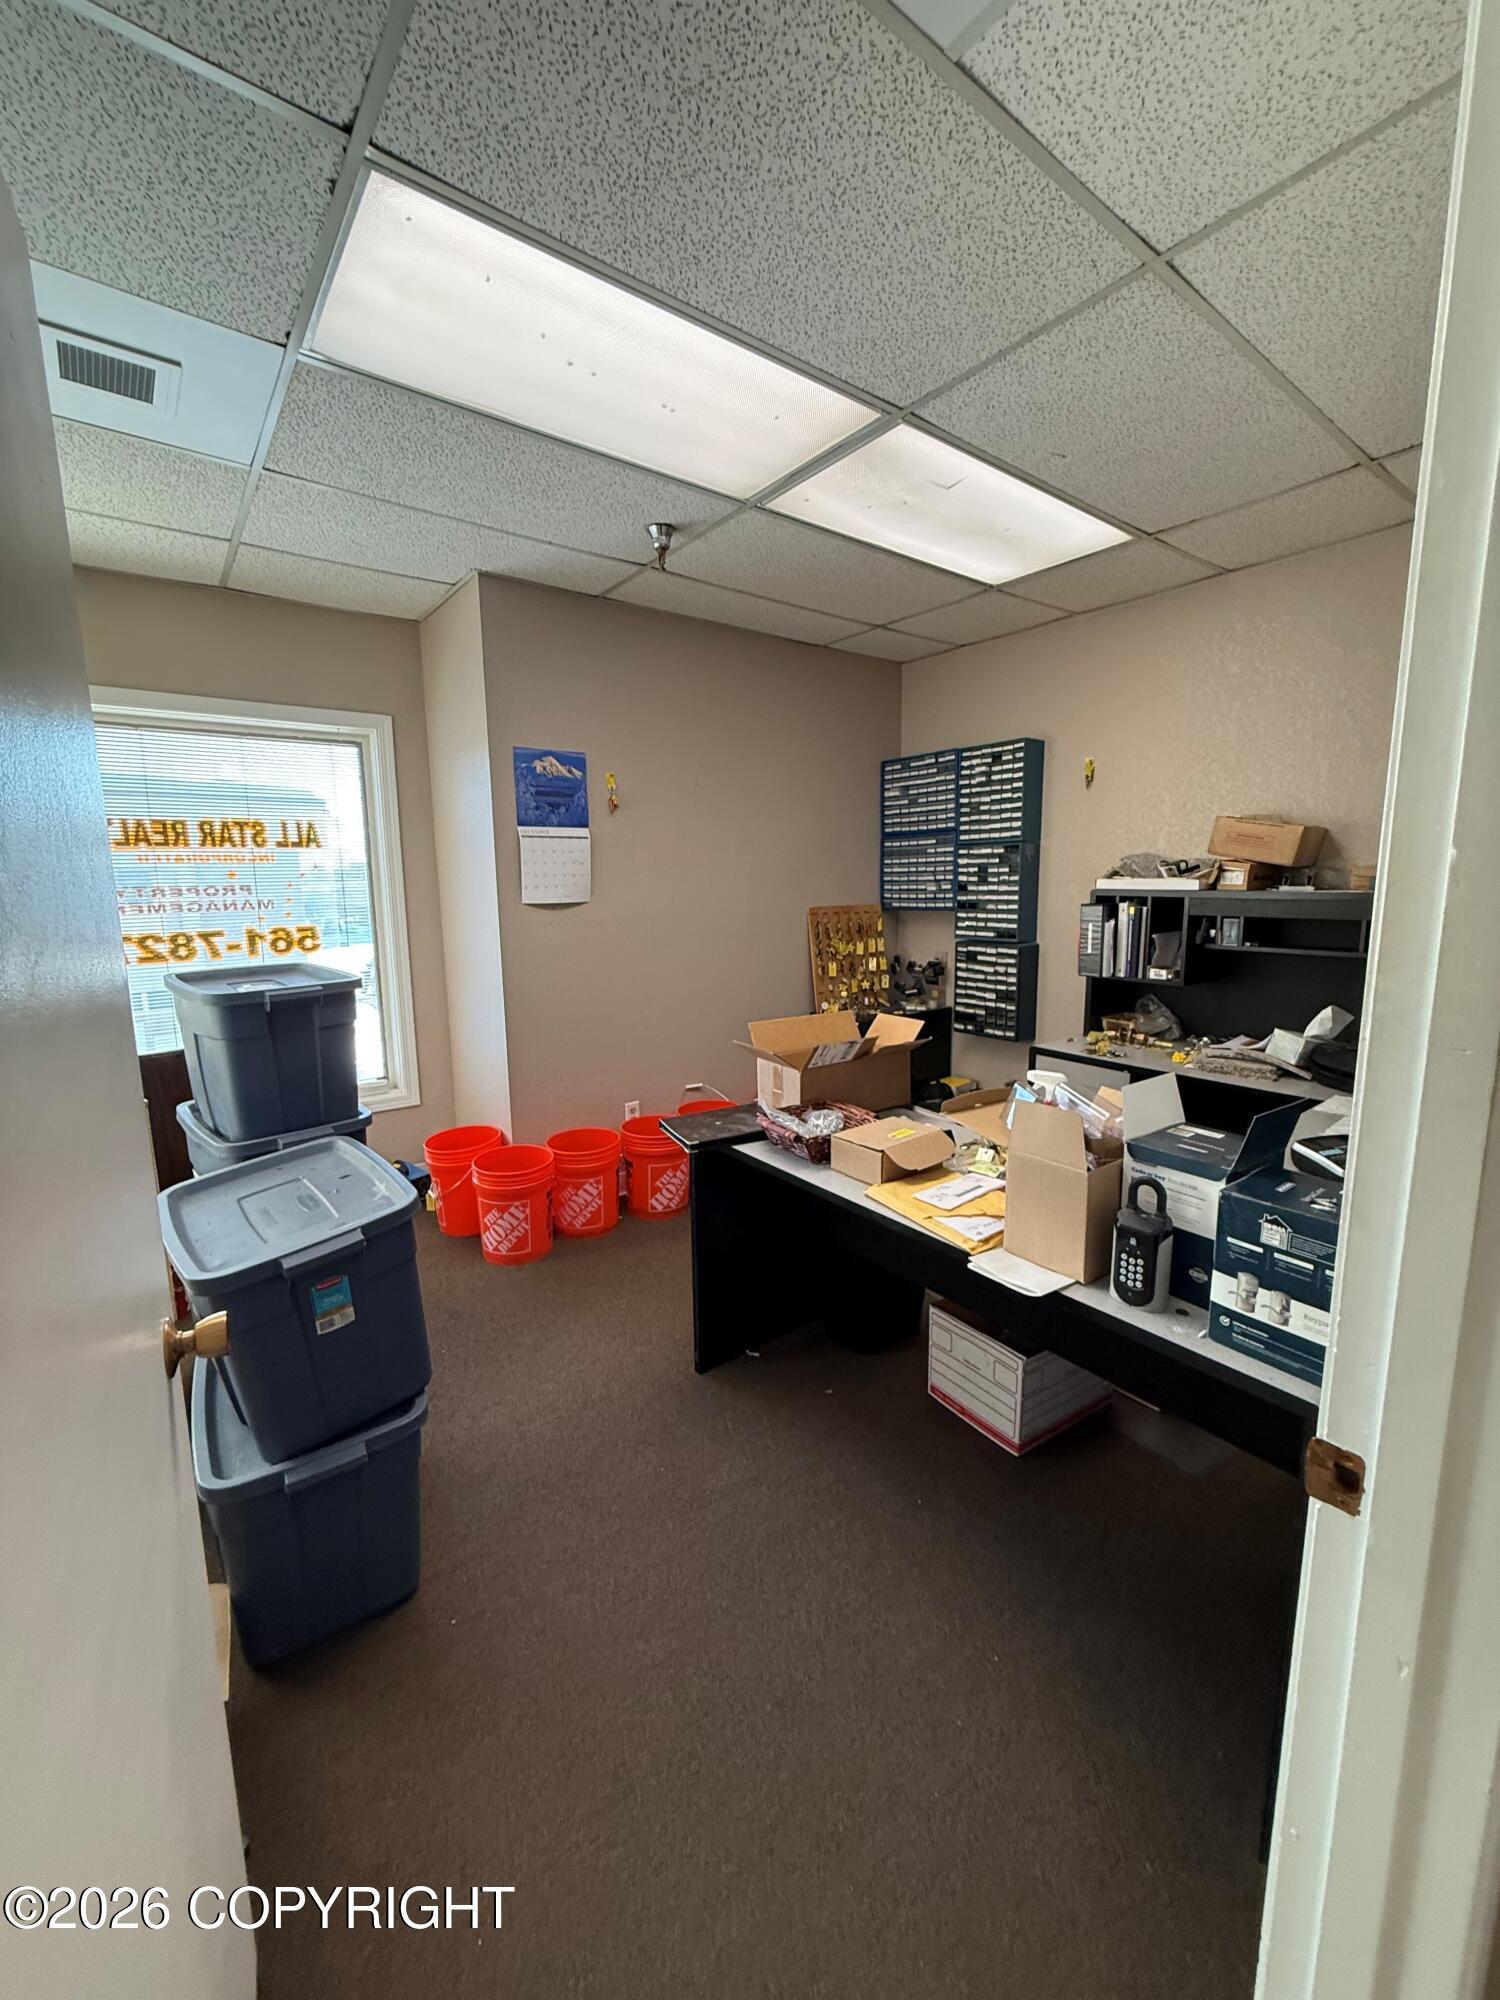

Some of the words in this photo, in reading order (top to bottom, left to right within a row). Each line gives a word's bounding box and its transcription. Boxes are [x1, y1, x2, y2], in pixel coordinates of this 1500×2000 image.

[560, 1185, 577, 1203] THE
[655, 1168, 675, 1188] THE
[484, 1208, 502, 1227] THE
[557, 1180, 602, 1225] HOME
[572, 1196, 602, 1229] DEPOT
[483, 1203, 528, 1250] HOME
[498, 1222, 529, 1254] DEPOT
